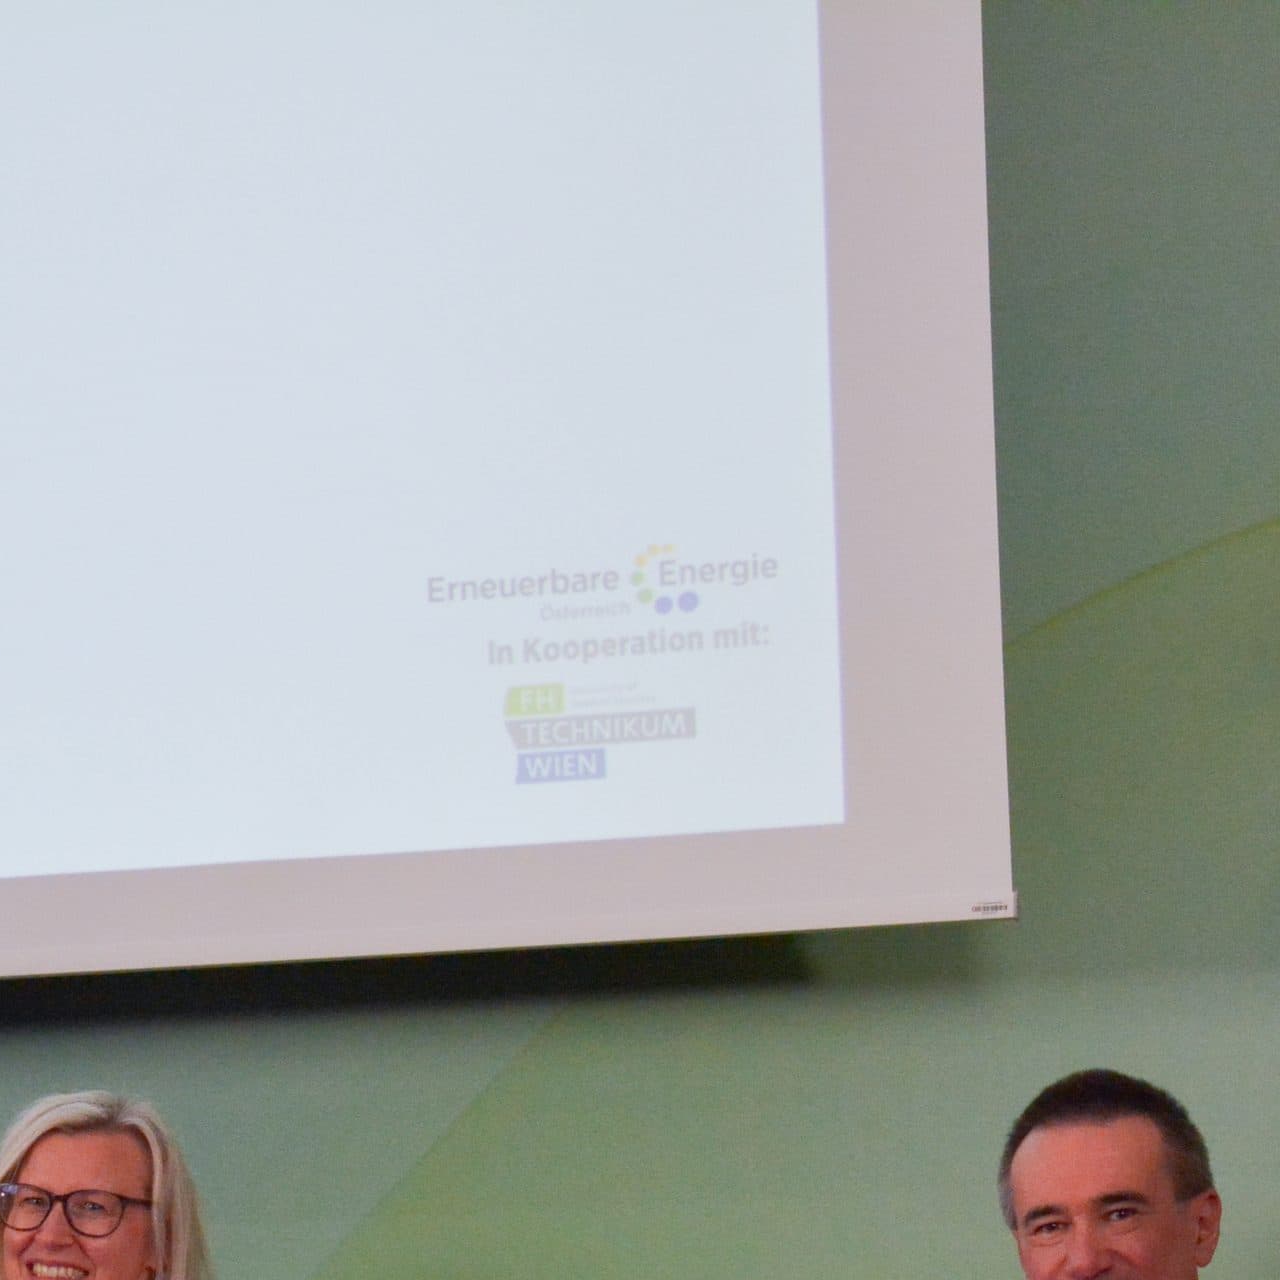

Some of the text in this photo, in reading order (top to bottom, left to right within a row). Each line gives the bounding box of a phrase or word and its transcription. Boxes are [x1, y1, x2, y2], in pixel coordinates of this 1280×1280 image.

[426, 552, 780, 603] Erneuerbare Energie
[487, 620, 771, 666] In Kooperation mit:
[520, 712, 686, 746] TECHNIKUM
[525, 753, 597, 779] WIEN
